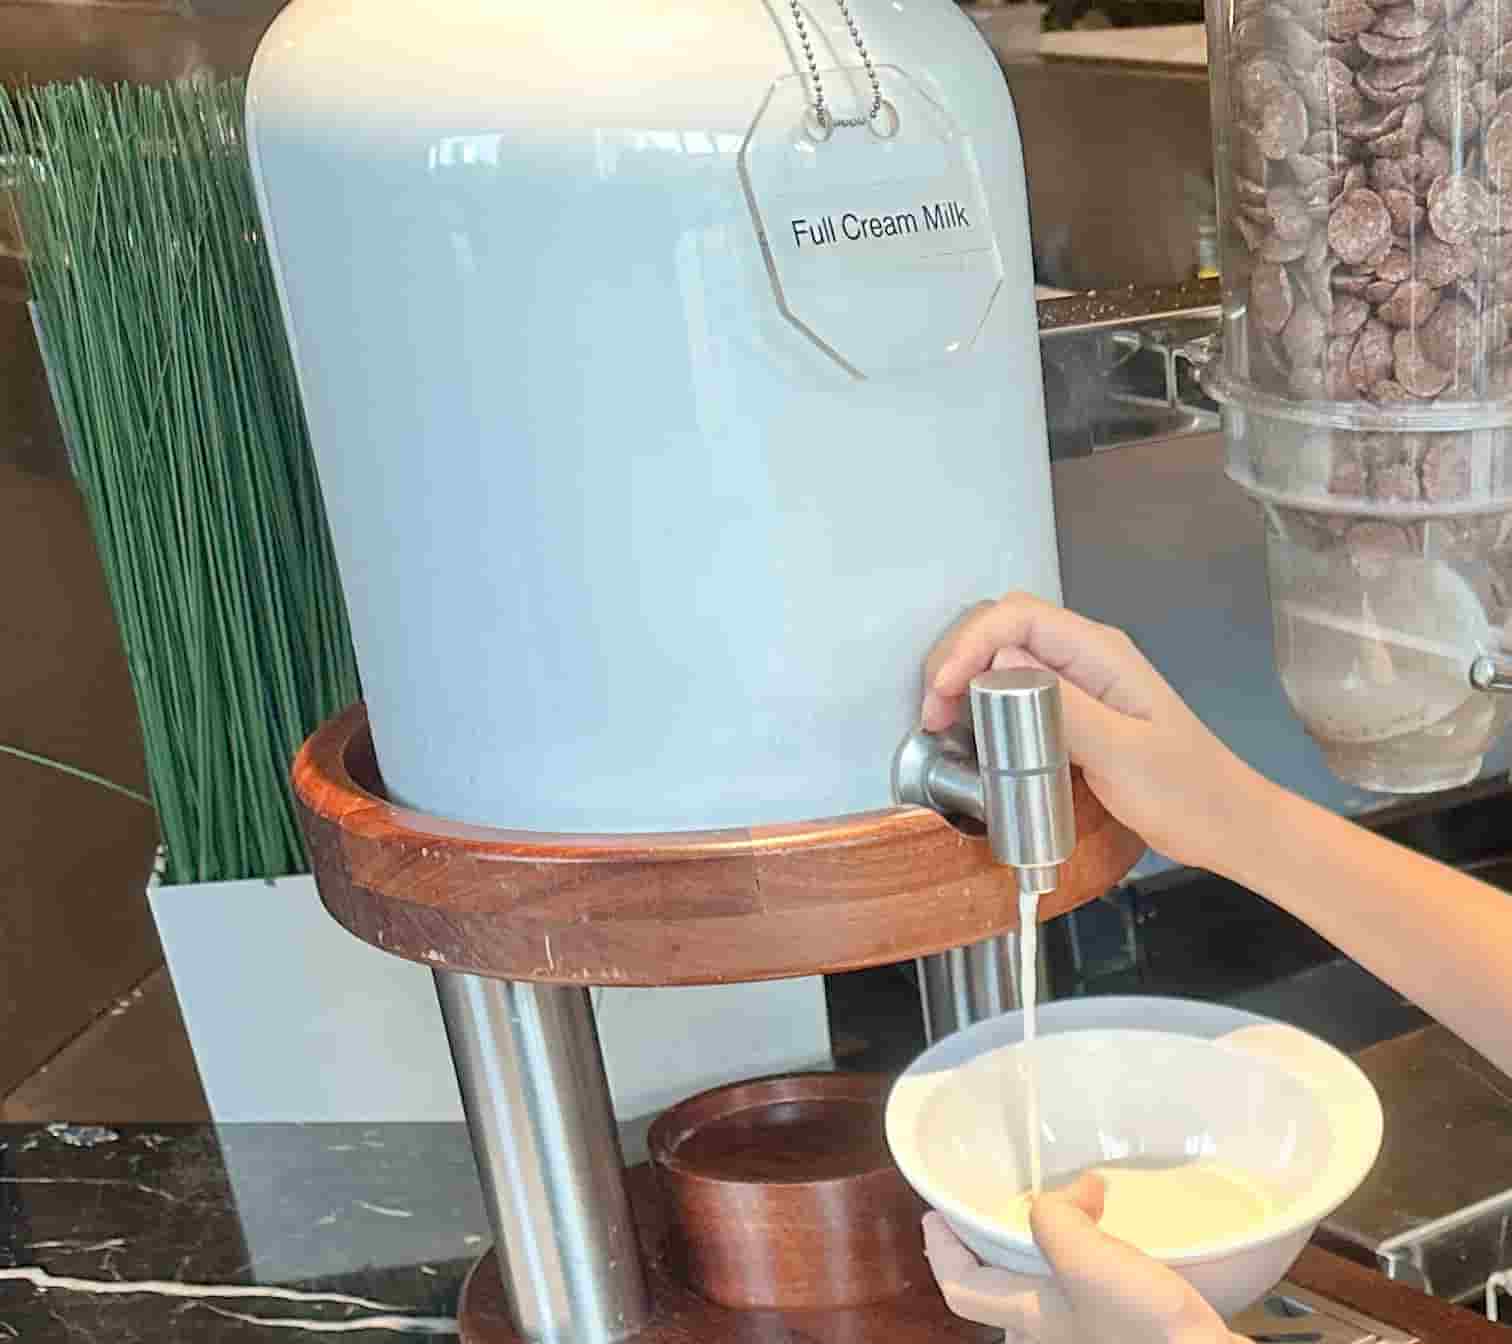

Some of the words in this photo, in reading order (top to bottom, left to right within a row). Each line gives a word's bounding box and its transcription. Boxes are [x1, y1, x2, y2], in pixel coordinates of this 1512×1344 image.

[791, 216, 837, 247] Full
[841, 212, 918, 241] Cream
[921, 201, 970, 232] Milk
